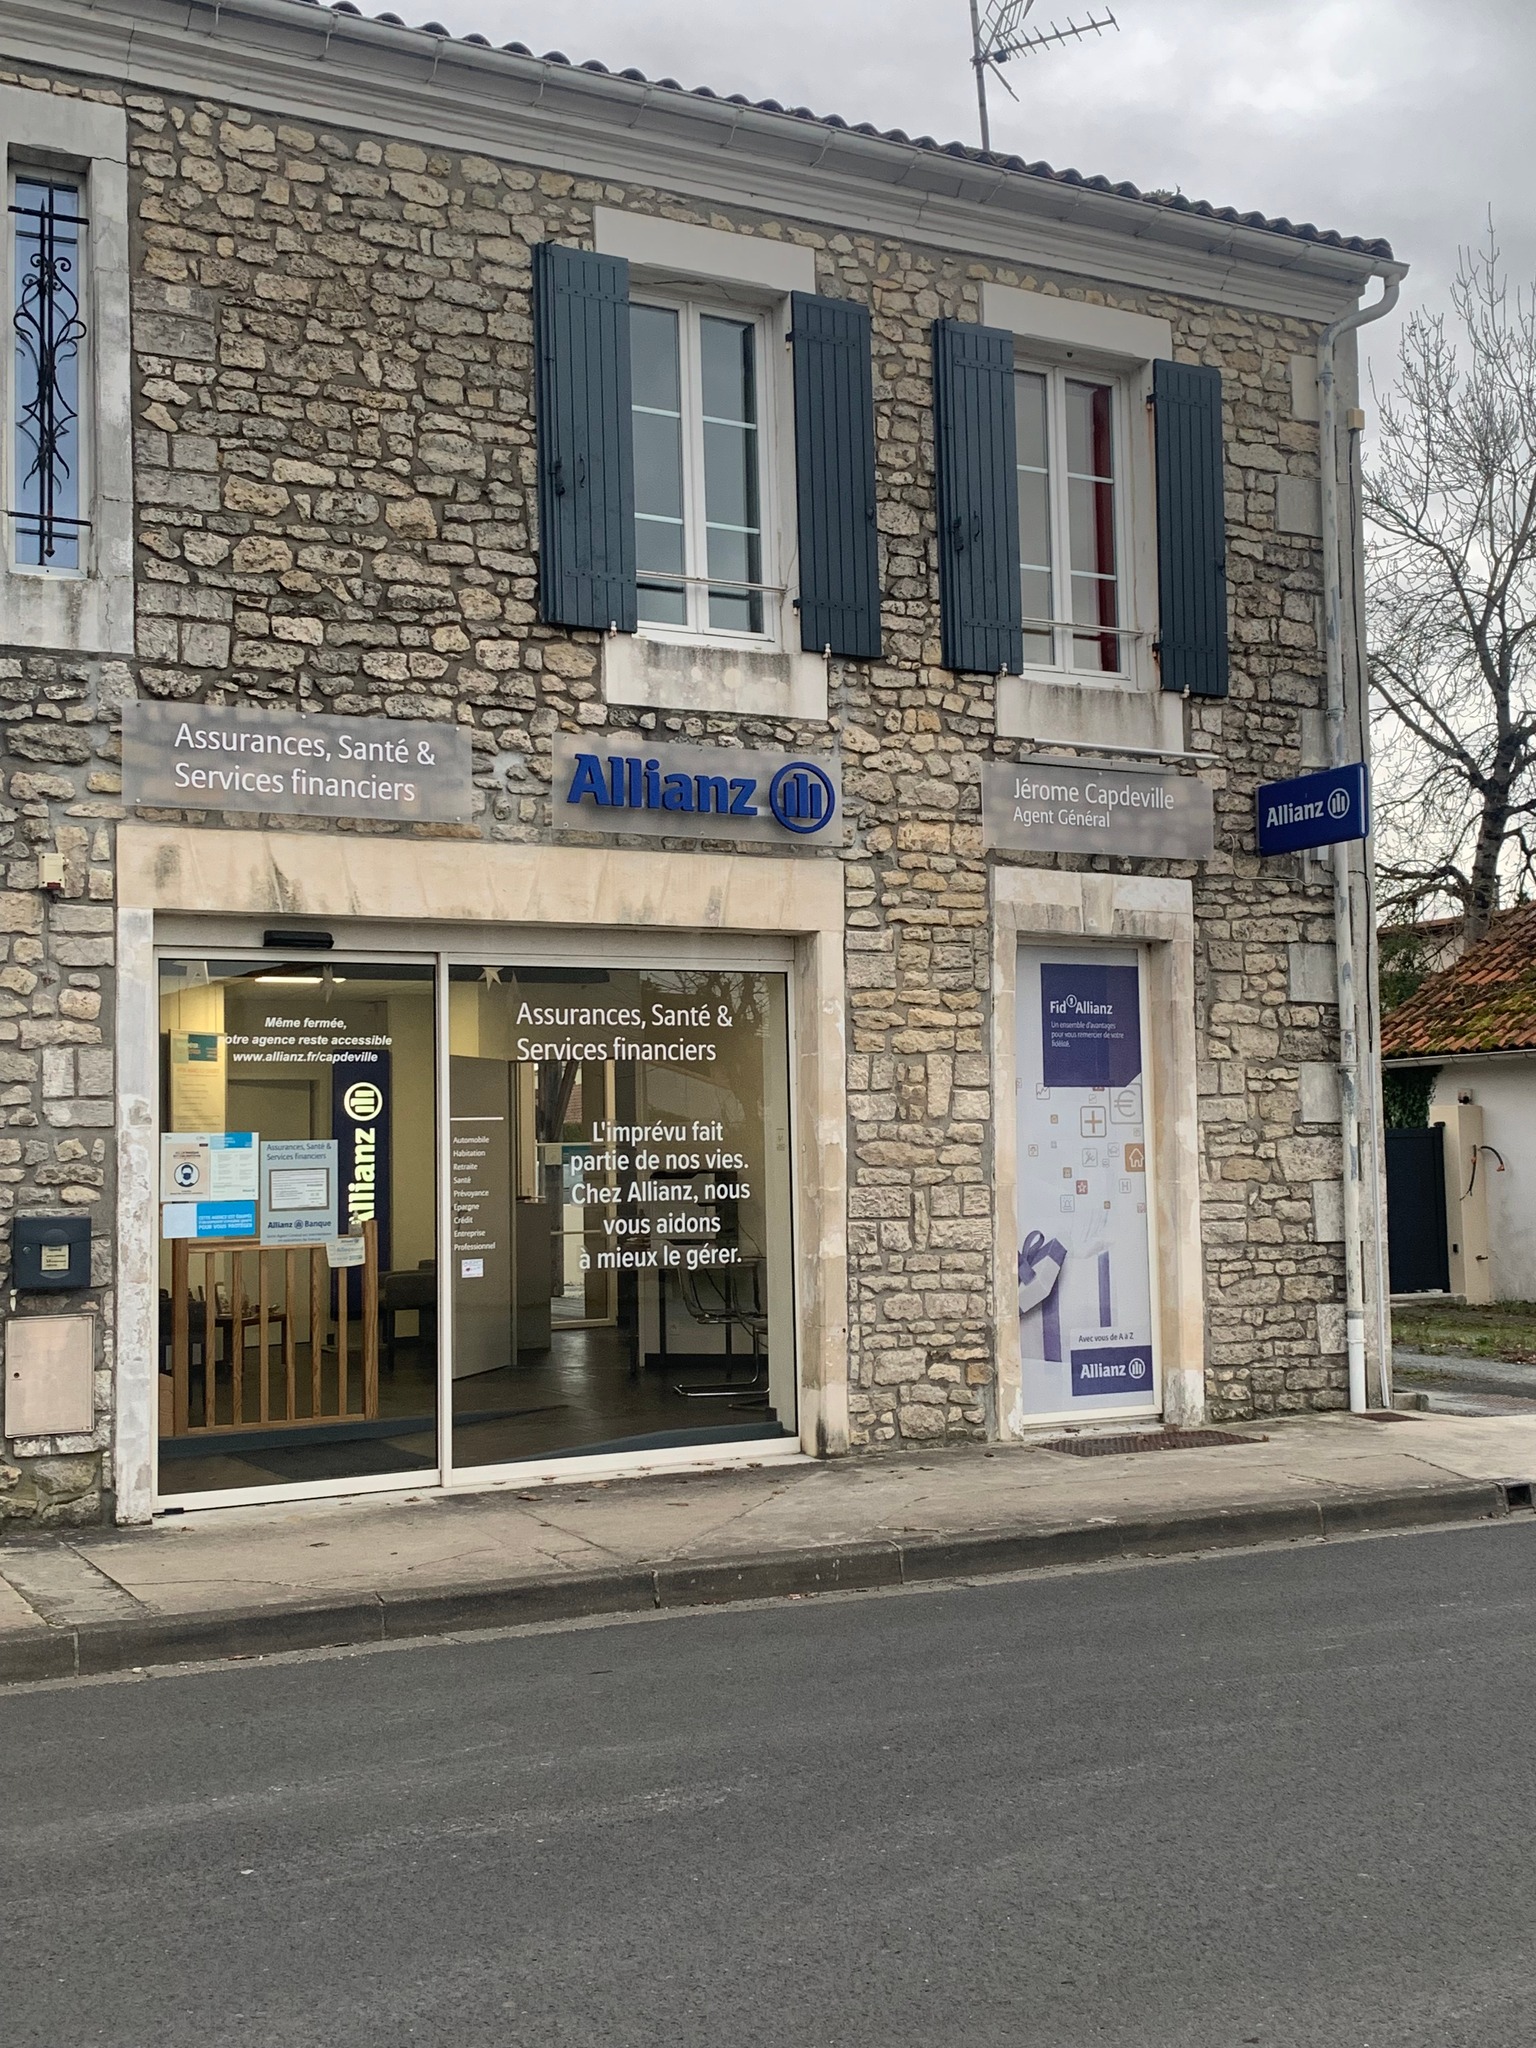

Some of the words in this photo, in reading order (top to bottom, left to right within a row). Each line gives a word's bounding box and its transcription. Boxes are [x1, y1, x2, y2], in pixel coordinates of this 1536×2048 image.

[174, 722, 331, 762] Assurances,
[338, 734, 409, 764] Santé
[416, 740, 436, 766] &
[174, 762, 284, 793] Services
[291, 768, 415, 802] financiers
[566, 753, 758, 815] Allianz
[1013, 777, 1079, 802] Jérome
[1085, 783, 1174, 811] Capdeville
[1013, 806, 1054, 827] Agent
[1058, 808, 1110, 828] Général
[1266, 800, 1325, 828] Allianz
[516, 1002, 646, 1029] Assurances,
[651, 1003, 711, 1027] Santé
[717, 1005, 733, 1027] &
[264, 1017, 301, 1028] Même
[303, 1017, 347, 1030] fermée,
[1051, 1021, 1059, 1029] Un
[1060, 1021, 1085, 1029] ensemble
[1086, 1021, 1116, 1030] d'avantages
[218, 1034, 249, 1045] otre
[251, 1035, 295, 1047] agence
[298, 1035, 328, 1045] reste
[331, 1034, 393, 1046] accessible
[1077, 1031, 1102, 1039] remercier
[1103, 1031, 1110, 1039] de
[516, 1036, 608, 1061] Services
[613, 1036, 717, 1061] financiers
[233, 1051, 379, 1064] www.allianz.fr/capdeville
[453, 1136, 490, 1144] Automobile
[592, 1120, 686, 1147] L'imprévu
[692, 1120, 724, 1142] fait
[453, 1163, 478, 1171] Retraite
[570, 1150, 629, 1176] partie
[635, 1149, 660, 1171] de
[666, 1153, 700, 1170] nos
[705, 1148, 749, 1170] vies.
[453, 1176, 471, 1184] Santé
[453, 1189, 489, 1199] Prévoyance
[571, 1182, 622, 1204] Chez
[627, 1180, 699, 1203] Allianz,
[704, 1182, 751, 1200] nous
[267, 1220, 293, 1229] Allianz
[304, 1219, 332, 1229] Banque
[454, 1216, 473, 1224] Crédit
[603, 1217, 651, 1235] vous
[656, 1212, 721, 1234] aidons
[454, 1229, 486, 1238] Entreprise
[454, 1241, 496, 1251] Professionnel
[579, 1247, 591, 1269] à
[597, 1246, 658, 1268] mieux
[664, 1244, 681, 1266] le
[686, 1242, 742, 1271] gérer.
[1078, 1335, 1094, 1343] Avec
[1109, 1333, 1118, 1341] de
[1129, 1332, 1134, 1340] Z
[1080, 1362, 1127, 1379] Allianz
